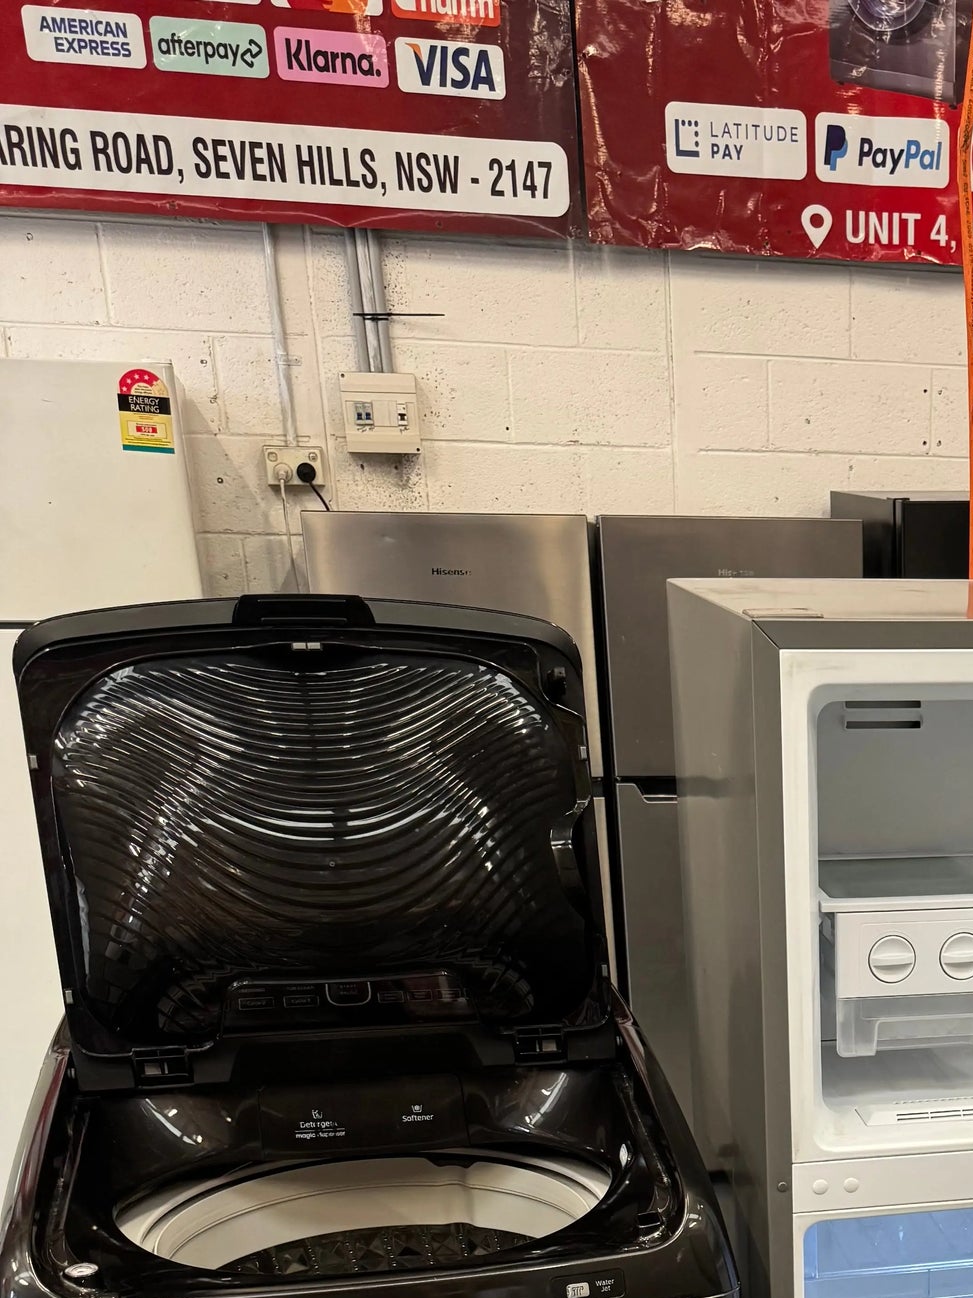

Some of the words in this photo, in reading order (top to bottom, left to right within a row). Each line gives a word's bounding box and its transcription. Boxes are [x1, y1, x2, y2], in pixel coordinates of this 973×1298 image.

[39, 15, 128, 39] AMERICAN
[54, 37, 132, 58] EXPRESS
[157, 32, 240, 67] afterpay
[284, 37, 381, 78] Klarna.
[404, 42, 496, 92] VISA
[710, 121, 799, 143] LATITUDE
[711, 143, 743, 161] PAY
[858, 137, 943, 175] PayPal
[89, 130, 184, 184] ROAD,
[192, 136, 288, 184] SEVEN
[295, 144, 387, 197] HILLS,
[395, 151, 460, 194] NSW
[488, 157, 553, 200] 2147
[846, 210, 921, 246] UNIT
[930, 214, 957, 253] 4,
[128, 396, 160, 405] ENERGY
[130, 404, 160, 413] RATING
[299, 1121, 338, 1129] Detrge
[402, 1114, 434, 1122] Softener
[595, 1279, 615, 1287] Water
